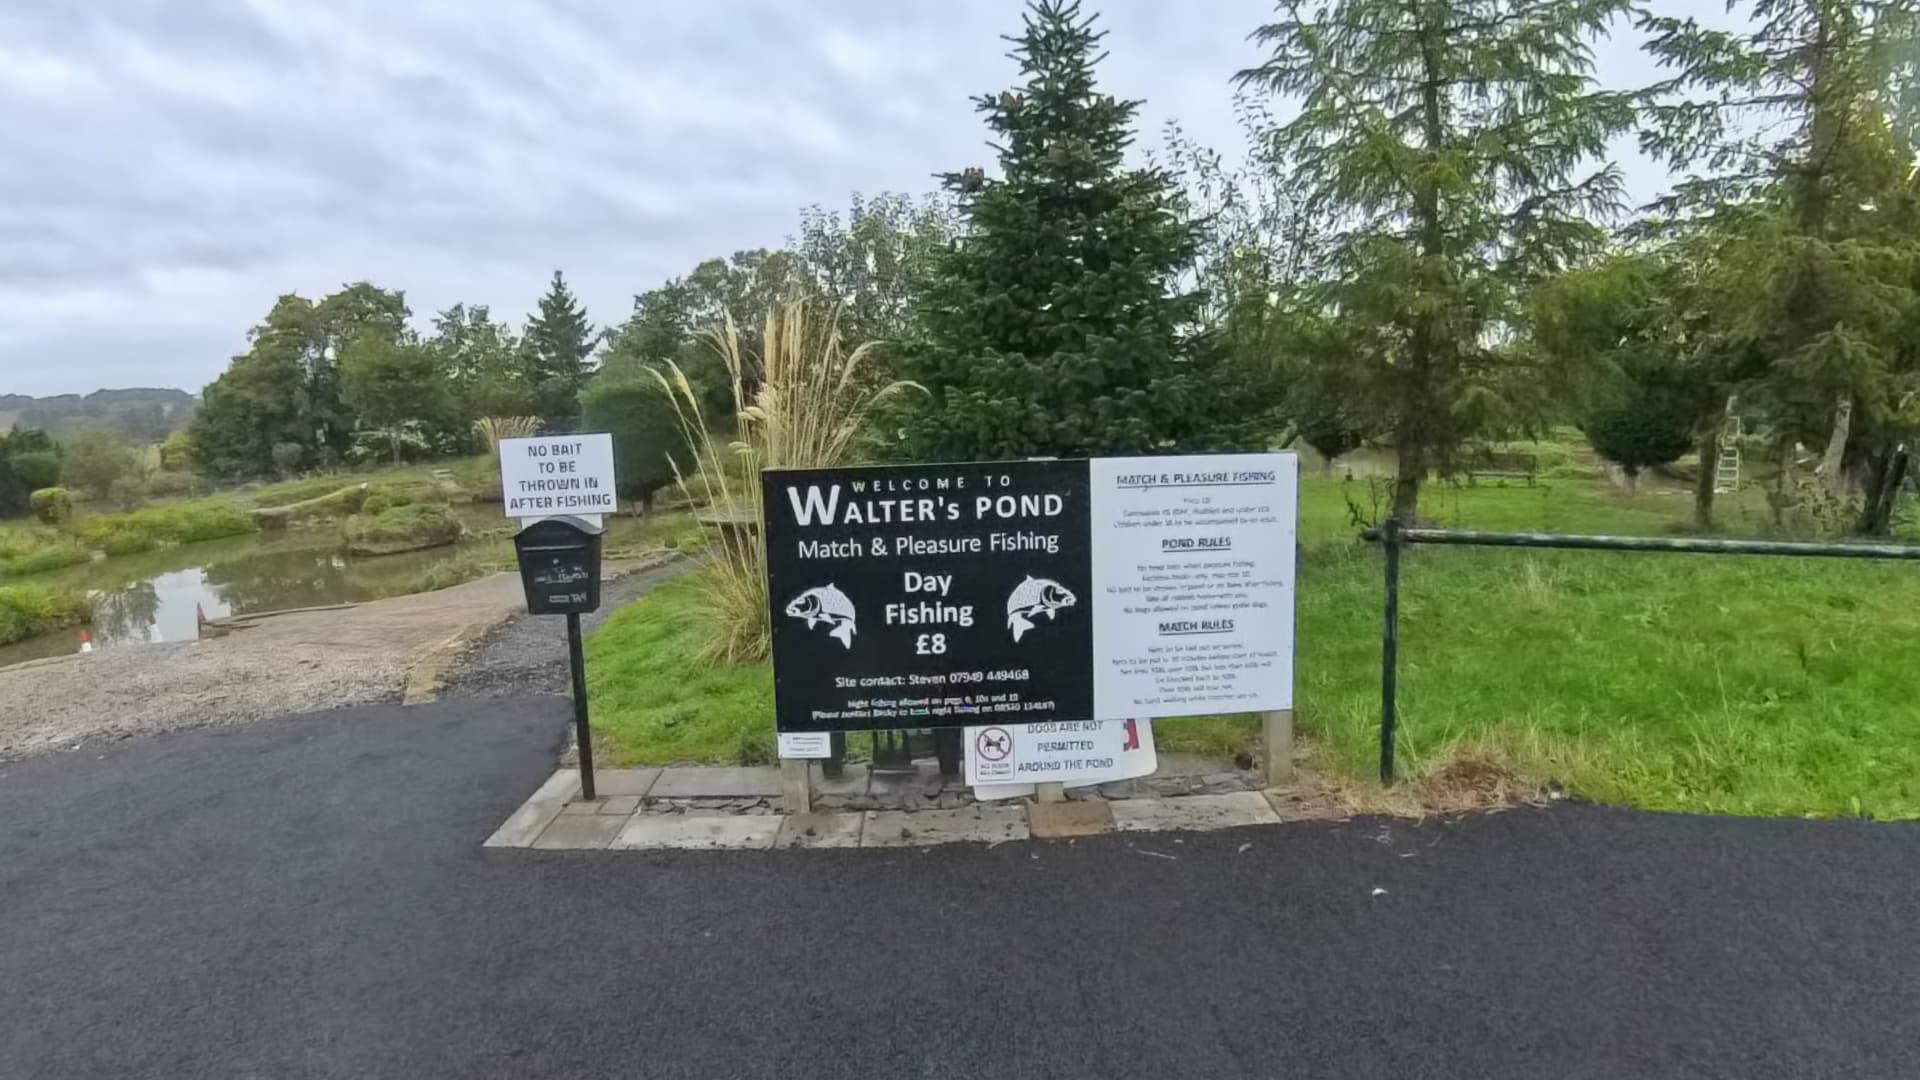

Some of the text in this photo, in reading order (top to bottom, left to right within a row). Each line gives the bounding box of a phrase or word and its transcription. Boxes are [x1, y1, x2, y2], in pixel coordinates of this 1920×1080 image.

[528, 443, 582, 457] NO BAIT
[538, 461, 576, 474] TO BE
[518, 477, 598, 492] THROWN IN
[852, 475, 1011, 493] WELCOME TO
[1116, 474, 1157, 485] MATCH
[1174, 471, 1228, 484] PLEASURE
[1233, 470, 1276, 482] FISHING
[510, 494, 611, 510] AFTER FISHING
[976, 494, 1064, 520] POND
[799, 531, 1060, 560] Match & Pleasure Fishing
[1162, 536, 1232, 549] POND RULES
[904, 571, 952, 596] Day
[885, 601, 974, 627] Fishing
[1159, 619, 1235, 632] MATCH RULES
[916, 633, 947, 655] £8
[835, 676, 857, 688] Site
[860, 675, 906, 687] contact:
[909, 673, 946, 686] Steven
[1027, 720, 1103, 734] DOGS ARE NOT
[1037, 740, 1094, 752] PERMITTED
[1018, 760, 1061, 772] AROUND
[1064, 758, 1082, 770] THE
[1086, 757, 1114, 769] POND
